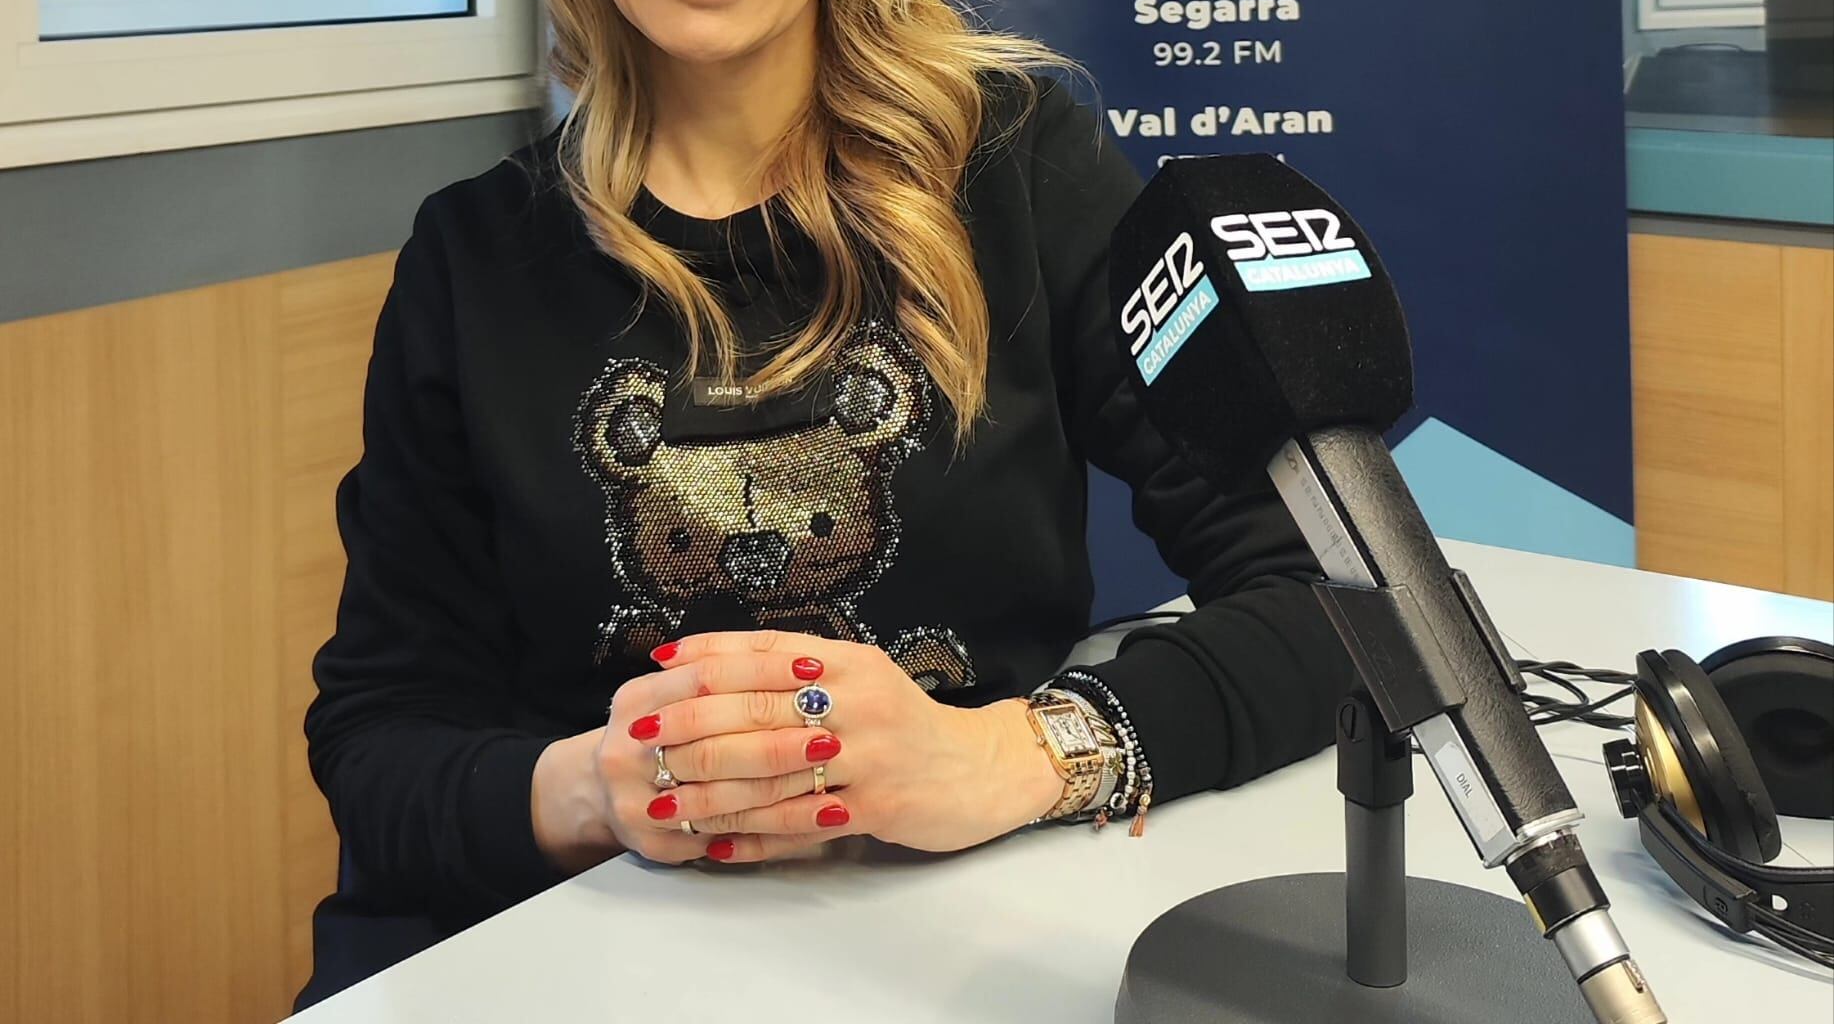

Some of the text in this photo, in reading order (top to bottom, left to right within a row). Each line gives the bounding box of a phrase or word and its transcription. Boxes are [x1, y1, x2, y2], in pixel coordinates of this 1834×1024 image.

[1153, 40, 1282, 66] 99.2 FM
[1107, 107, 1176, 136] Val
[1210, 208, 1356, 261] SER
[1249, 260, 1361, 285] CATALUNYA
[1121, 232, 1205, 356] SER
[1143, 290, 1213, 375] CATALUNYA
[708, 386, 743, 396] LOUIS
[1456, 772, 1473, 799] DIAL
